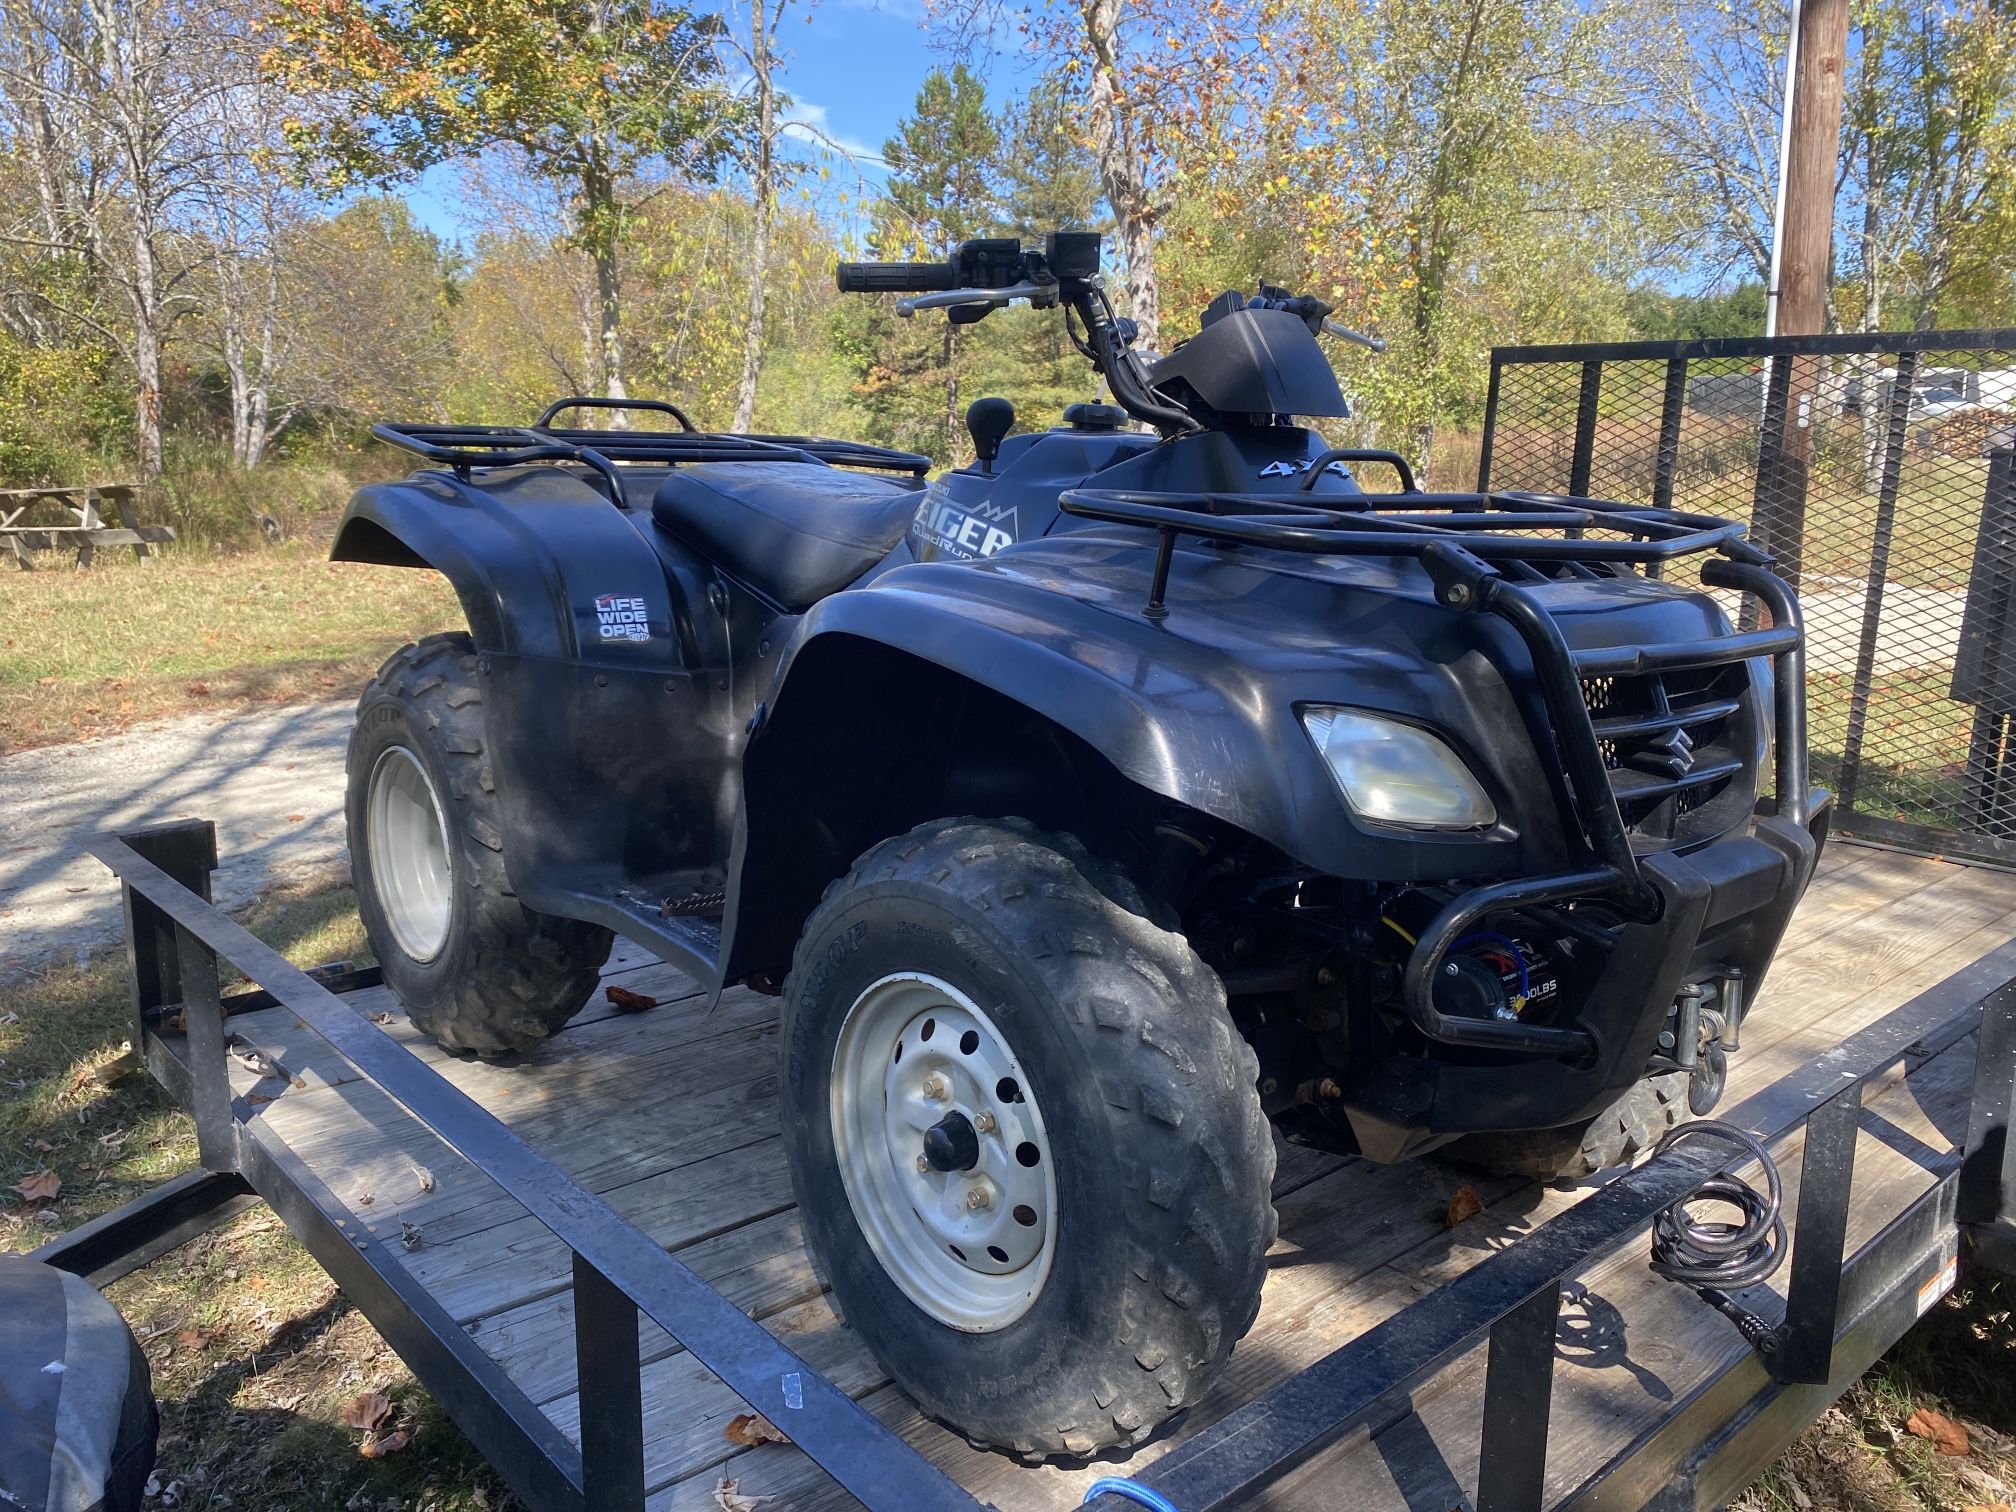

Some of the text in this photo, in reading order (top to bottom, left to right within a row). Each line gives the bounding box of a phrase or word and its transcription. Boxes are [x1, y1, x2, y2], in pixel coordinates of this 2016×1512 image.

[914, 497, 1013, 557] EIGER
[595, 597, 645, 612] LIFE
[597, 611, 648, 624] WIDE
[600, 623, 649, 638] OPEN
